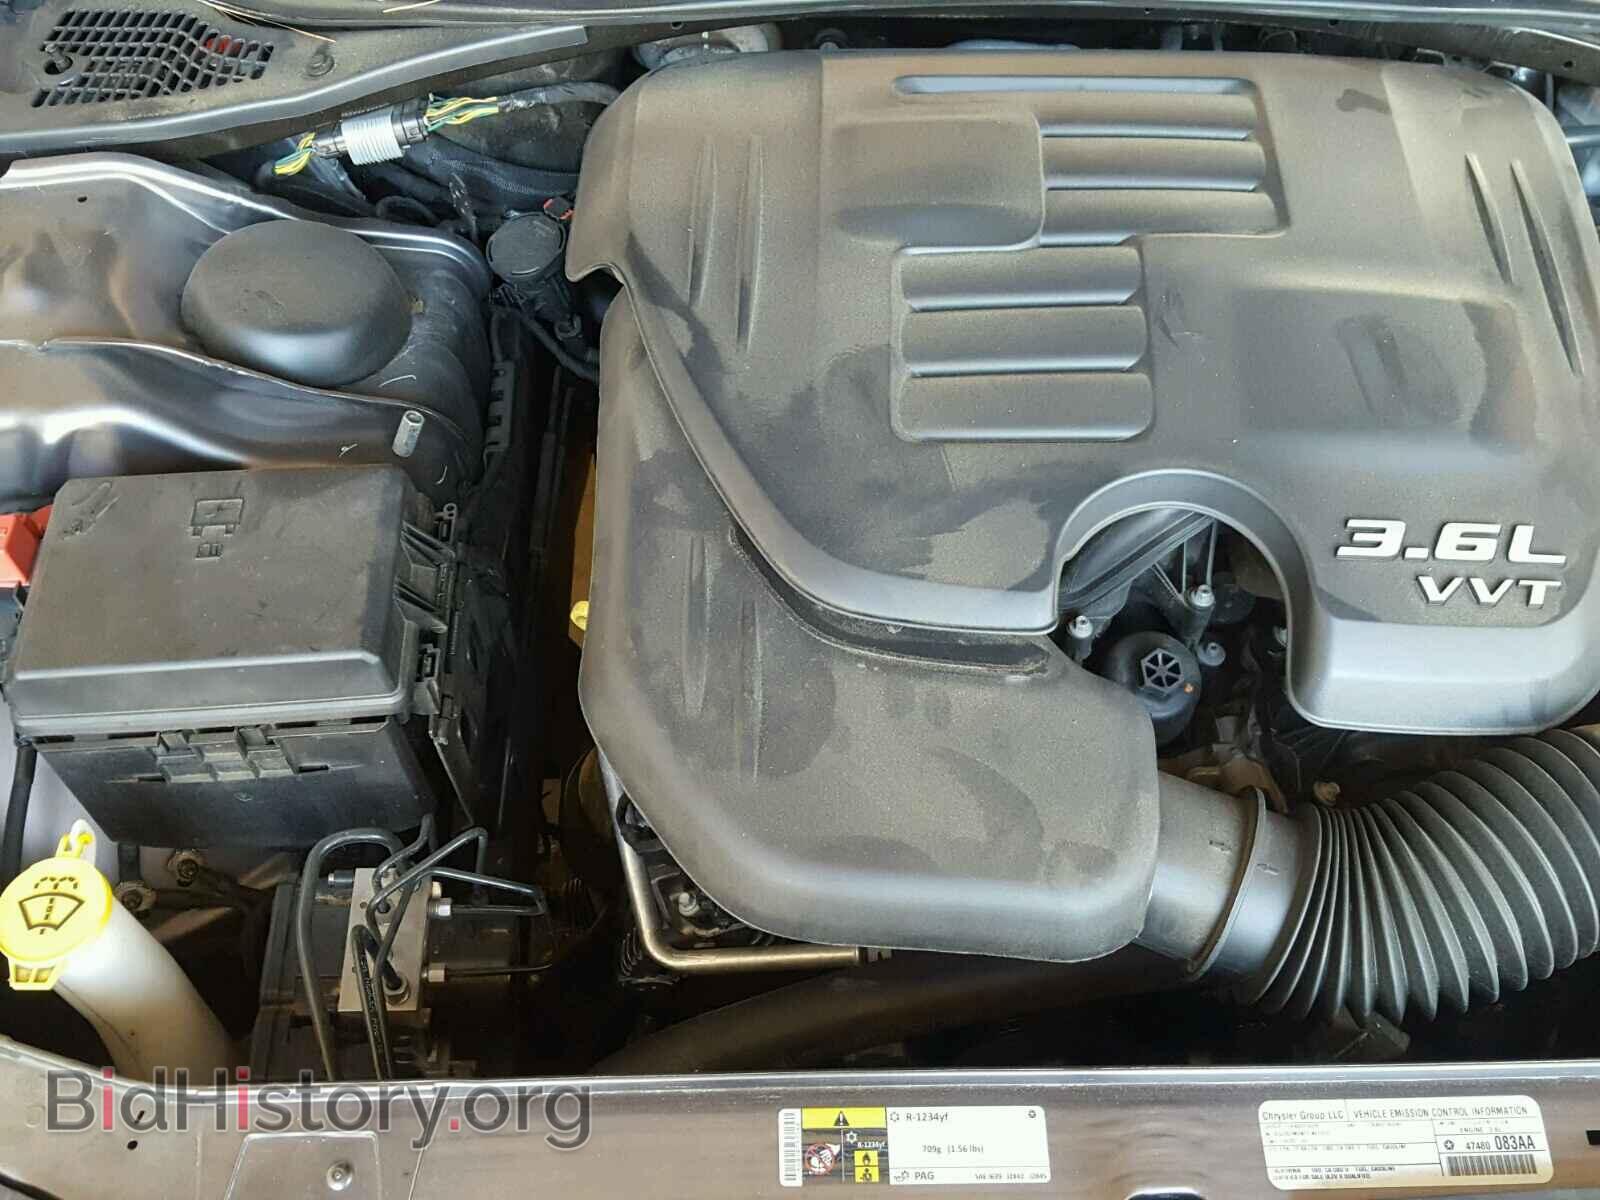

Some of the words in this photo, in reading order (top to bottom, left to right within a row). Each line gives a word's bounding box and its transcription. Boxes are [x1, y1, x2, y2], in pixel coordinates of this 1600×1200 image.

[1335, 518, 1568, 566] 3.6L
[1416, 575, 1562, 609] VVT
[906, 1111, 949, 1123] R-1234yf
[1262, 1111, 1297, 1121] Chrysler
[1299, 1110, 1325, 1120] Group
[1328, 1110, 1345, 1120] LLC
[1353, 1109, 1387, 1119] VEHICLE
[1389, 1108, 1429, 1118] EMISSION
[1431, 1107, 1469, 1117] CONTROL
[1471, 1105, 1528, 1116] INFORMATION
[1494, 1135, 1536, 1151] 083AA
[914, 1171, 935, 1181] PAG
